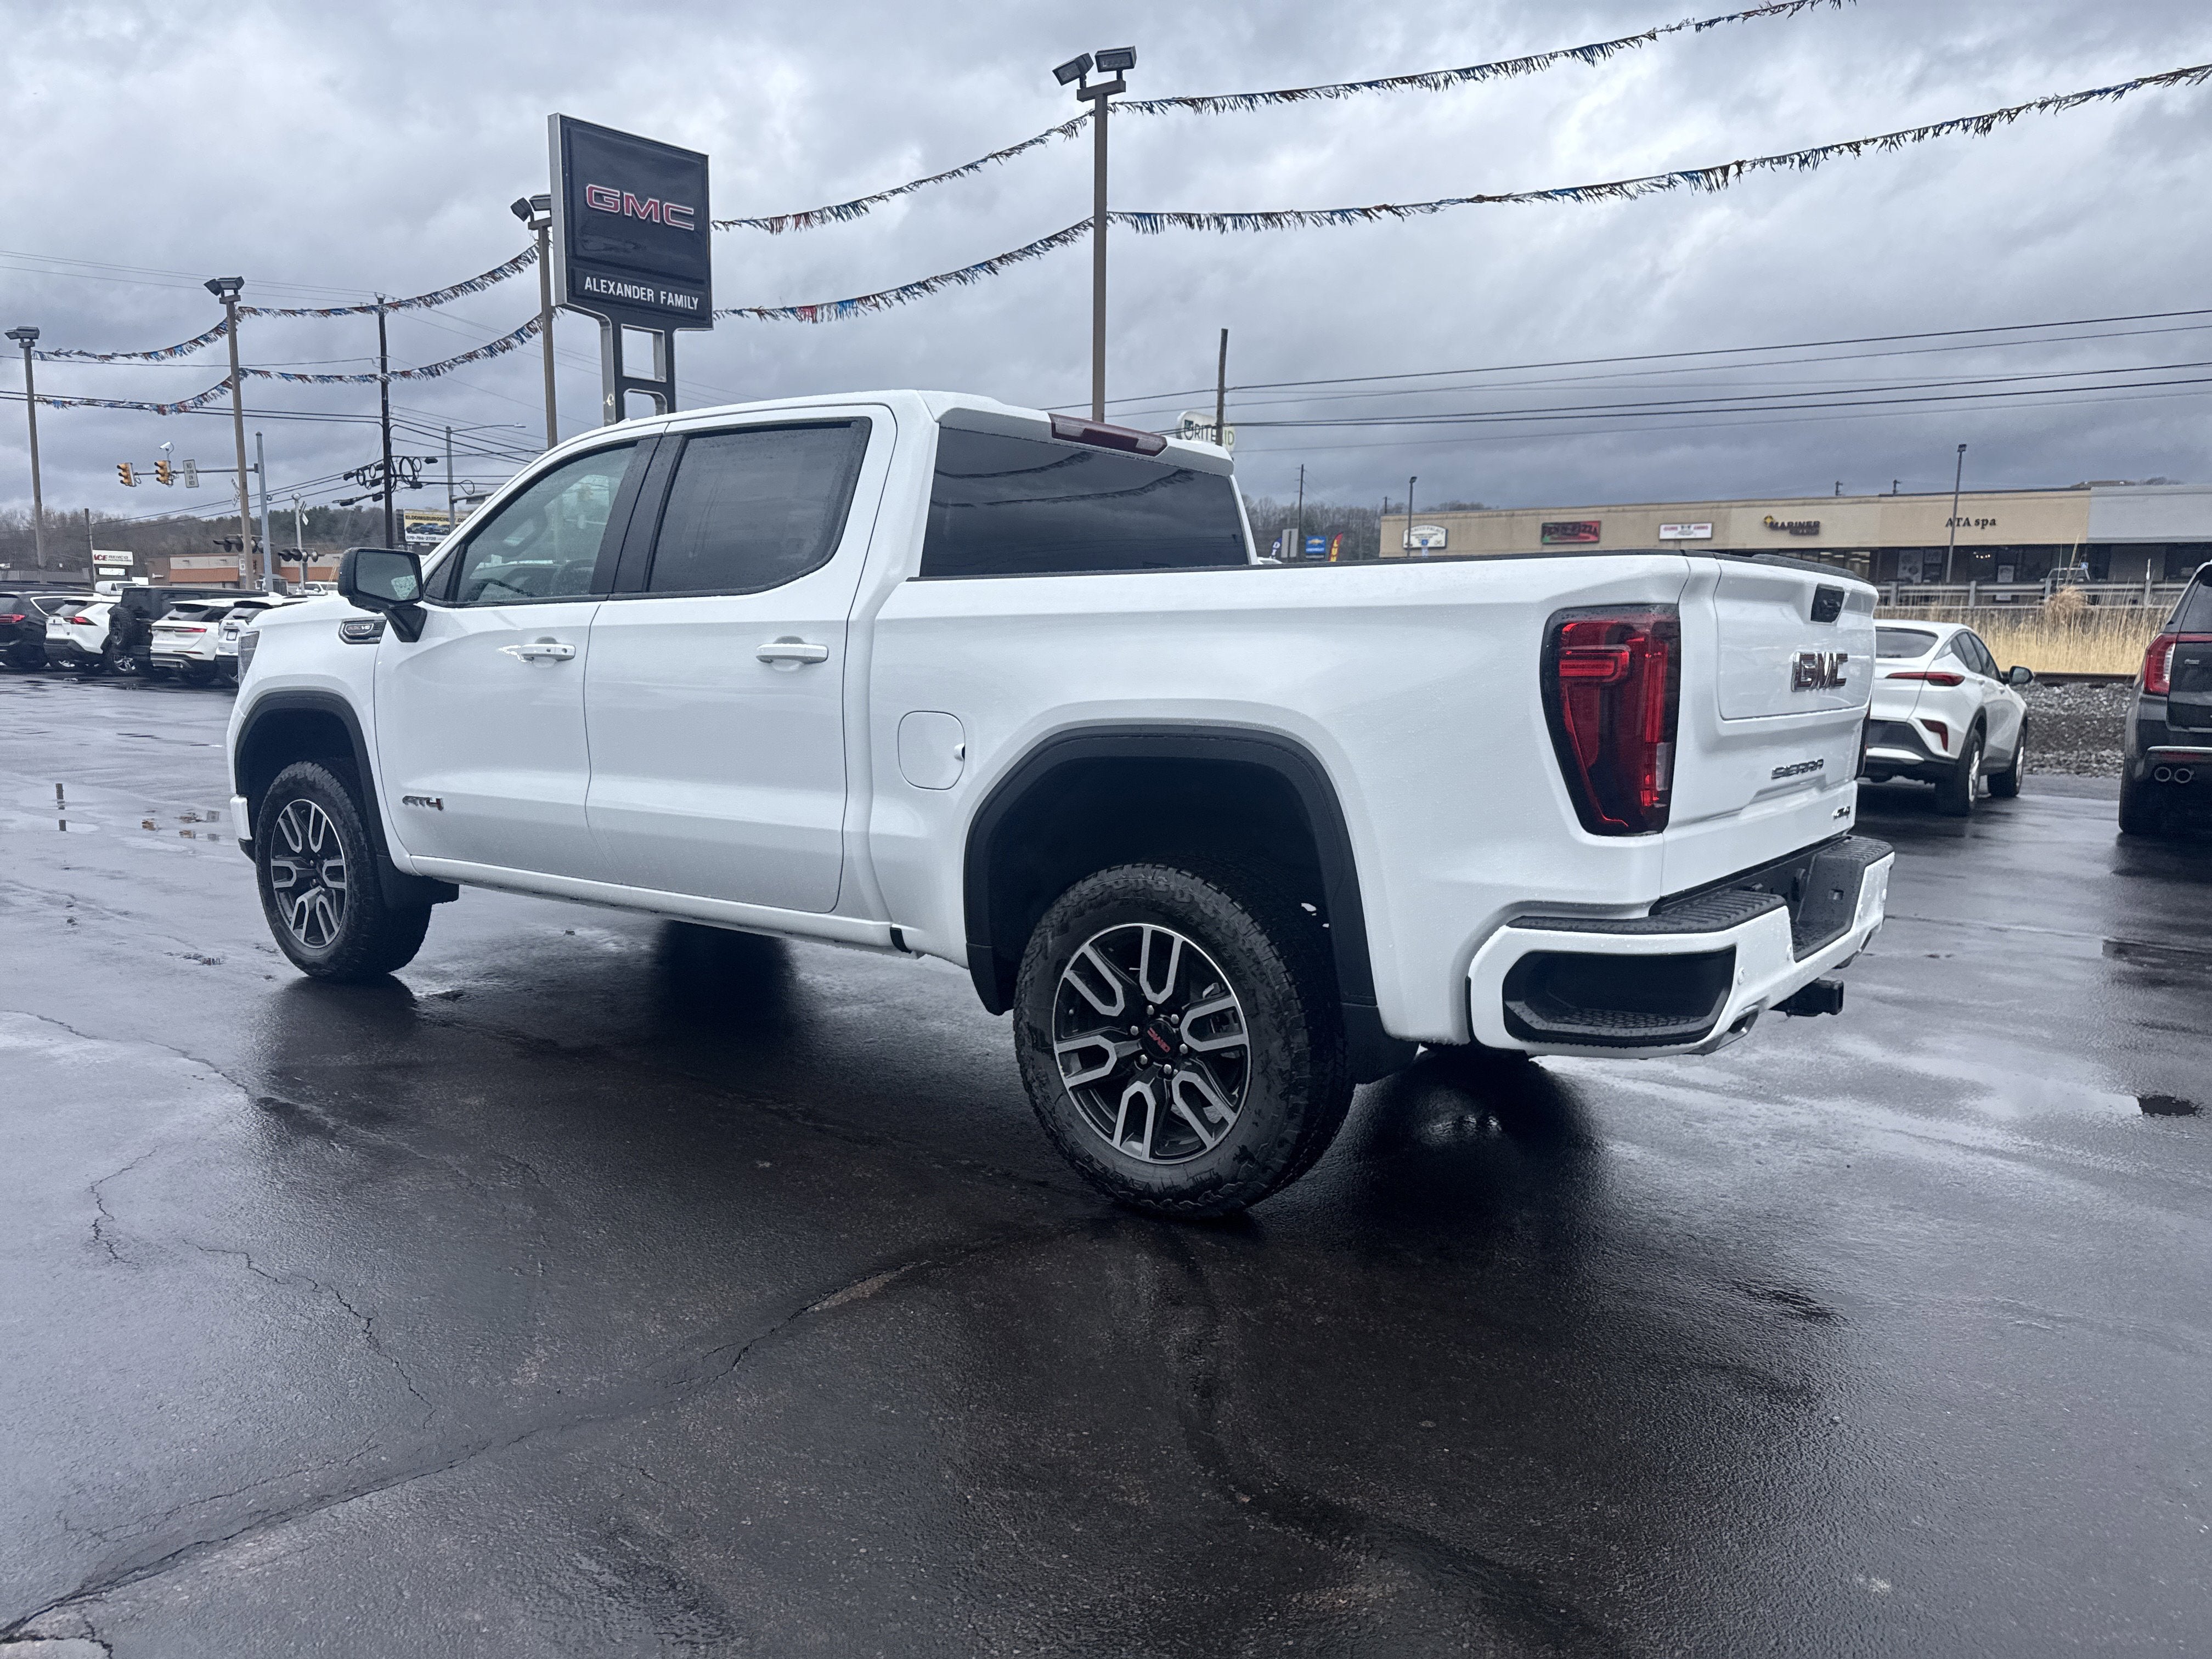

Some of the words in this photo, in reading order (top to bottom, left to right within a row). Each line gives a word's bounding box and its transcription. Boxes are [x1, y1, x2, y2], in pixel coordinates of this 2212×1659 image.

[586, 183, 695, 231] GMC
[584, 276, 654, 303] ALEXANDER
[660, 291, 699, 311] FAMILY
[1945, 517, 1971, 527] ATA
[1974, 518, 1996, 529] spa
[1791, 651, 1848, 692] GMC
[1771, 759, 1824, 780] SIERRA
